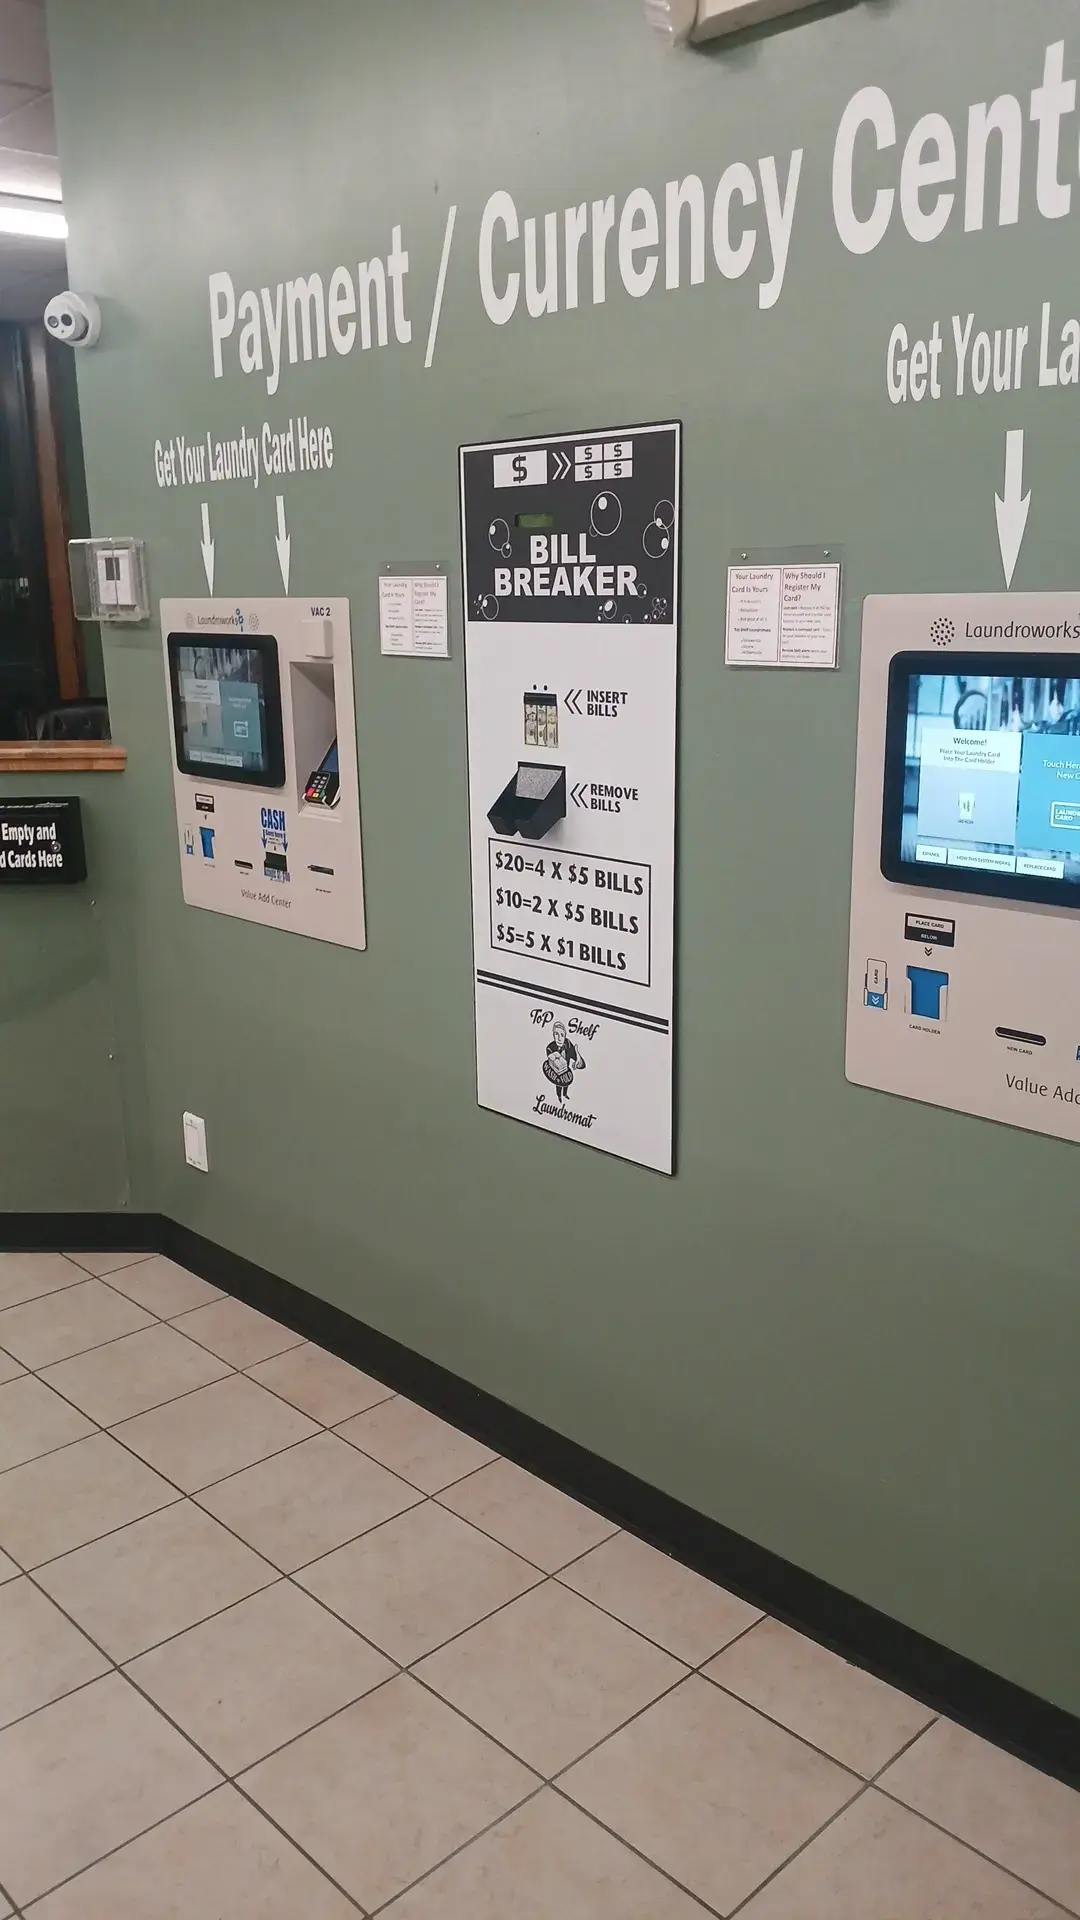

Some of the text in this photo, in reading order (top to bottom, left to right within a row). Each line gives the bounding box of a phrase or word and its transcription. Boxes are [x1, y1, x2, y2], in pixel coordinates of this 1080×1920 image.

[208, 40, 1080, 395] Payment / Currency Cent
[886, 301, 1080, 405] Get Your La
[154, 416, 333, 489] Get Your Laundry Card Here
[530, 532, 597, 564] BILL
[494, 565, 638, 597] BREAKER
[749, 573, 773, 581] Laundry
[785, 573, 799, 581] Why
[800, 572, 822, 580] Should
[784, 584, 821, 592] Register My
[311, 607, 331, 617] VAC 2
[965, 620, 1080, 639] Laundroworks
[587, 690, 628, 705] INSERT
[587, 703, 618, 718] BILLS
[953, 737, 988, 746] Welcome!
[1042, 760, 1080, 770] Touch Her
[1056, 770, 1074, 780] New
[590, 784, 639, 801] REMOVE
[590, 798, 621, 814] BILLS
[261, 807, 286, 832] CASH
[1, 822, 57, 846] Empty and
[8, 850, 37, 869] Cards
[38, 850, 63, 868] Here
[495, 850, 644, 896] $20=4 X $5 BILLS
[241, 889, 292, 909] Value Add Center
[496, 887, 639, 935] $10=2 X $5 BILLS
[497, 923, 627, 971] $5=5 X $1 BILLS
[568, 1018, 600, 1041] Shelf
[922, 1026, 941, 1035] HOLDER
[1006, 1073, 1048, 1097] Value
[532, 1094, 597, 1128] Laundromat
